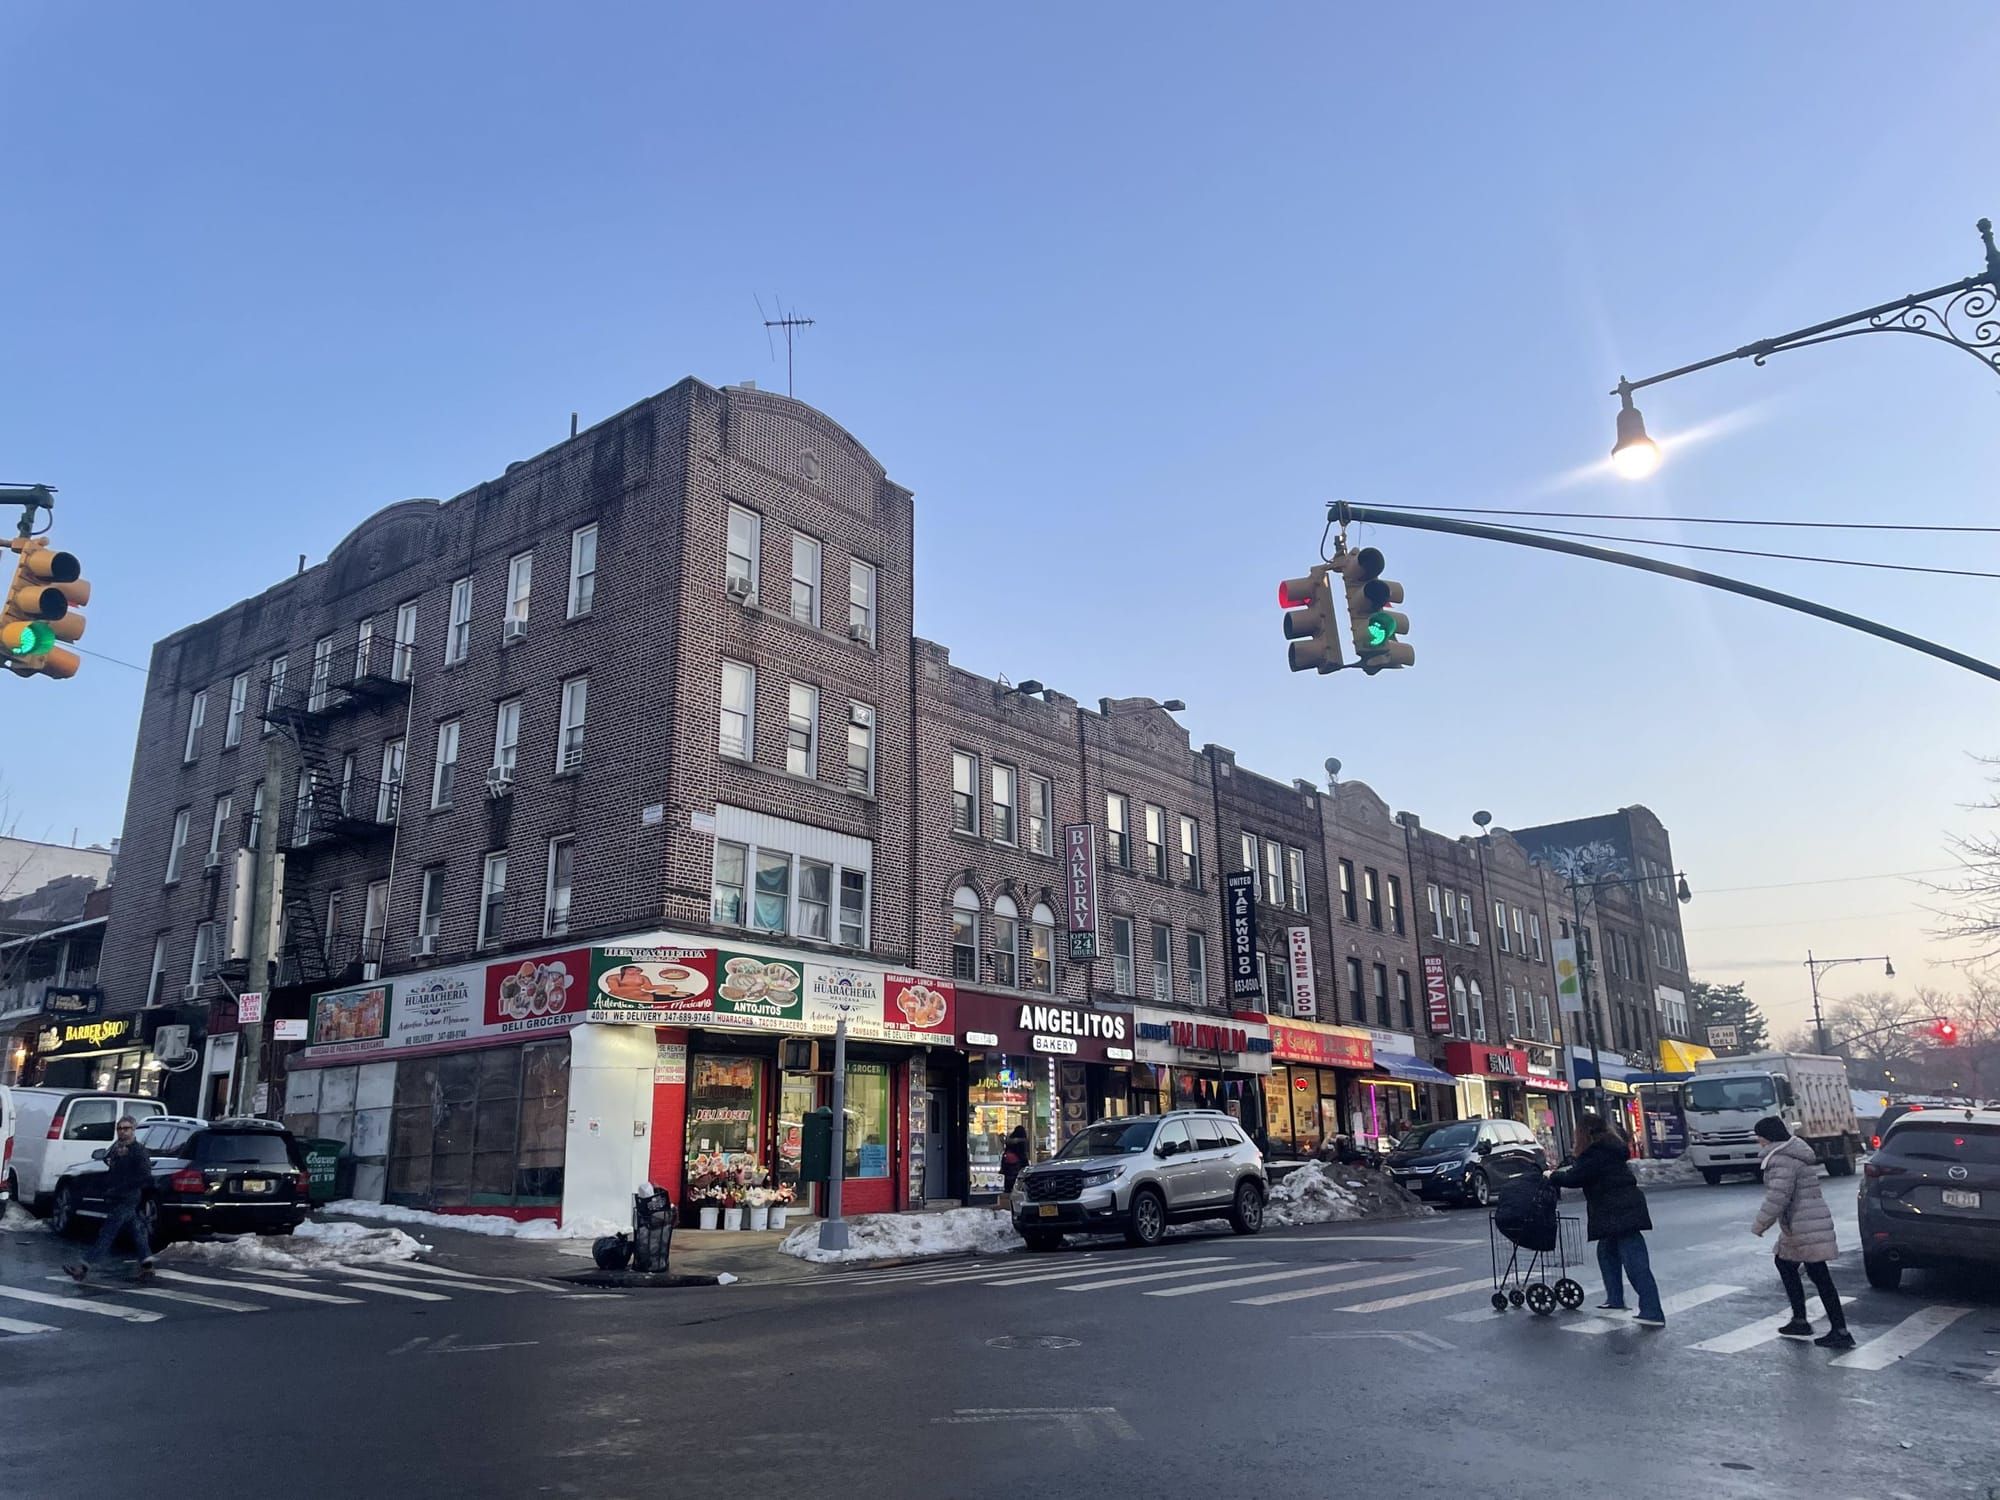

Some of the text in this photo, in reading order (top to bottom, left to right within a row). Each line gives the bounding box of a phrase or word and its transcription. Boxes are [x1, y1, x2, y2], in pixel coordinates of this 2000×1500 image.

[1071, 830, 1089, 928] BAKERY
[1229, 876, 1251, 887] UNITED
[1234, 888, 1251, 974] TAE KWON DO
[1073, 940, 1092, 949] 24
[1293, 931, 1311, 1012] CHINESE FOOD
[405, 988, 468, 1006] HUARACHERIA
[814, 983, 876, 999] HUARACHERIA
[591, 1011, 608, 1020] 4001
[613, 1011, 624, 1021] WE
[626, 1012, 661, 1021] DELIVERY
[733, 1002, 782, 1016] ANTOJITOS
[502, 1014, 574, 1032] DELI GROCERY
[717, 1014, 754, 1026] HUARACHES
[759, 1018, 777, 1028] TACOS
[1019, 1005, 1126, 1039] ANGELITOS
[66, 1023, 102, 1045] BARBER
[101, 1021, 129, 1039] SHOP
[1036, 1038, 1074, 1051] BAKERY
